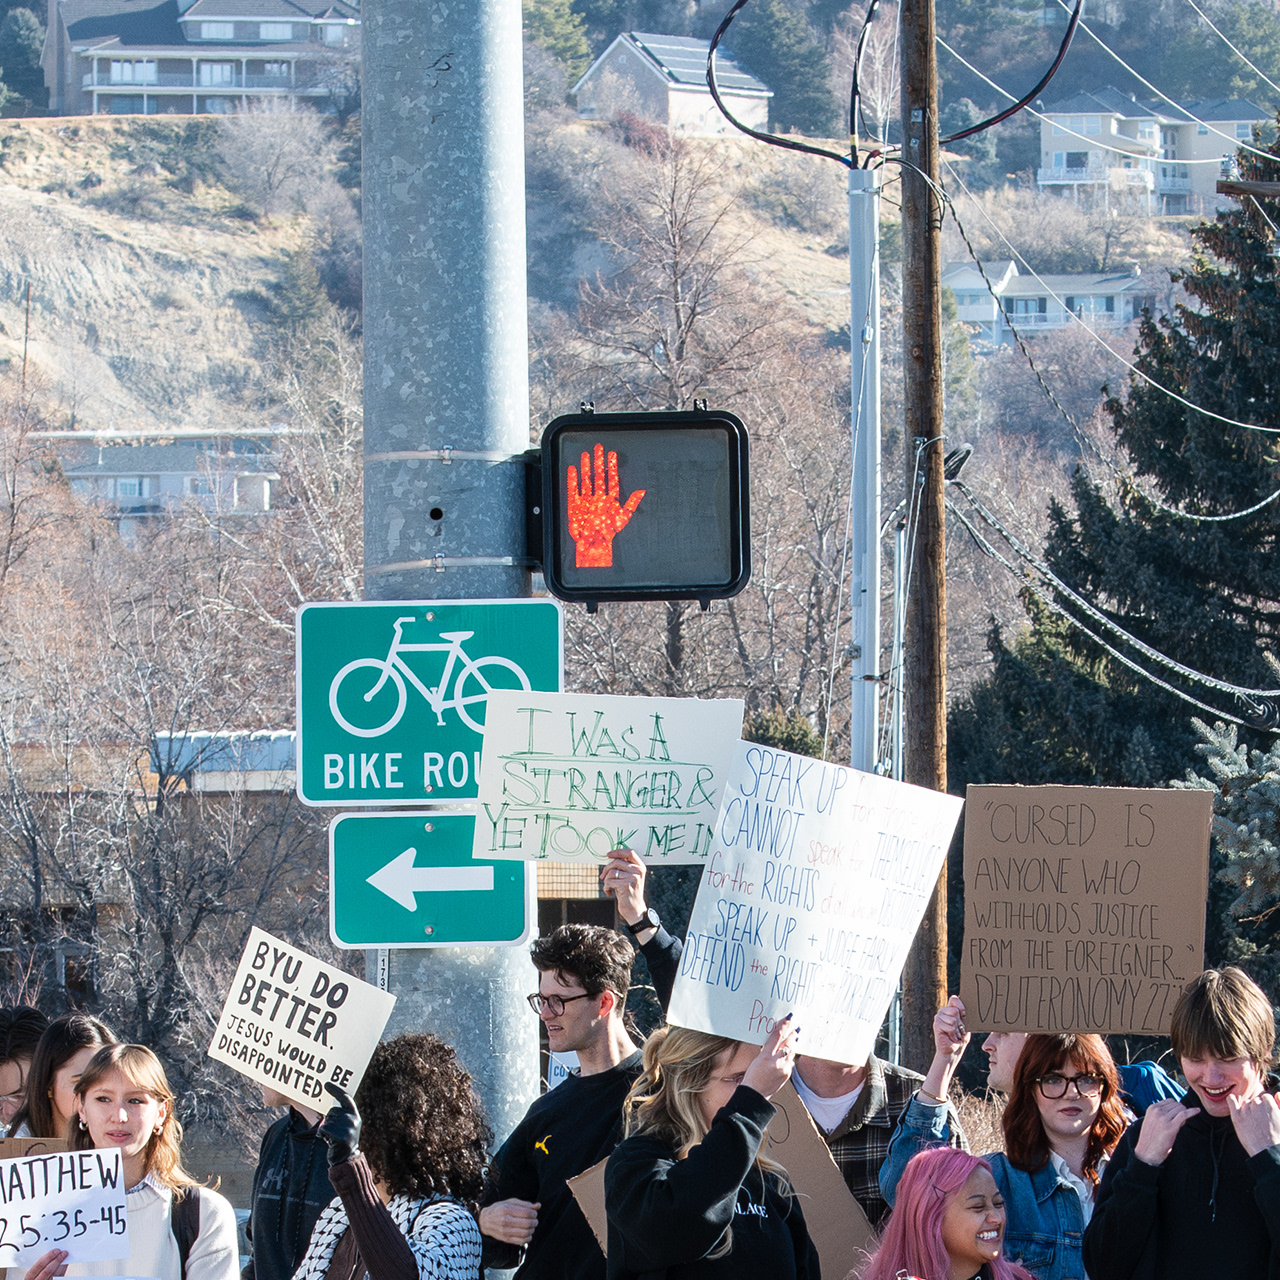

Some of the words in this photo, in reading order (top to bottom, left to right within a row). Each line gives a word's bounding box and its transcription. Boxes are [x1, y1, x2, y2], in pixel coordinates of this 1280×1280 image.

[515, 708, 553, 755] I
[649, 711, 671, 761] A
[324, 752, 404, 789] BIKE
[503, 761, 683, 810] STRANGER
[687, 767, 718, 810] &
[740, 748, 814, 809] SPEAK
[816, 766, 847, 815] UP
[482, 803, 527, 852] YE
[532, 813, 638, 860] TOOK
[646, 825, 687, 857] ME
[721, 797, 805, 861] CANNOT
[983, 801, 1097, 846] "CURSED
[1124, 803, 1155, 848] IS
[706, 850, 732, 888] for
[732, 863, 756, 896] the
[761, 861, 820, 912] RIGHTS
[974, 857, 1072, 894] ANYONE
[1082, 859, 1141, 896] WHO
[716, 898, 769, 948] SPEAK
[774, 918, 797, 951] UP
[819, 926, 860, 969] JUDGE
[973, 901, 1081, 935] WITHHOLDS
[1088, 902, 1161, 940] JUSTICE
[252, 941, 302, 991] BYU,
[310, 971, 349, 1009] DO
[681, 931, 745, 992] DEFEND
[751, 958, 769, 977] the
[771, 955, 822, 1006] RIGHTS
[970, 938, 1013, 969] FROM
[1024, 939, 1055, 971] THE
[238, 973, 338, 1050] BETTER.
[975, 973, 1142, 1031] DEUTERONOMY
[218, 1034, 324, 1102] DISAPPOINTED.
[227, 1014, 273, 1046] JESUS
[278, 1038, 327, 1074] WOULD
[330, 1065, 353, 1088] BE
